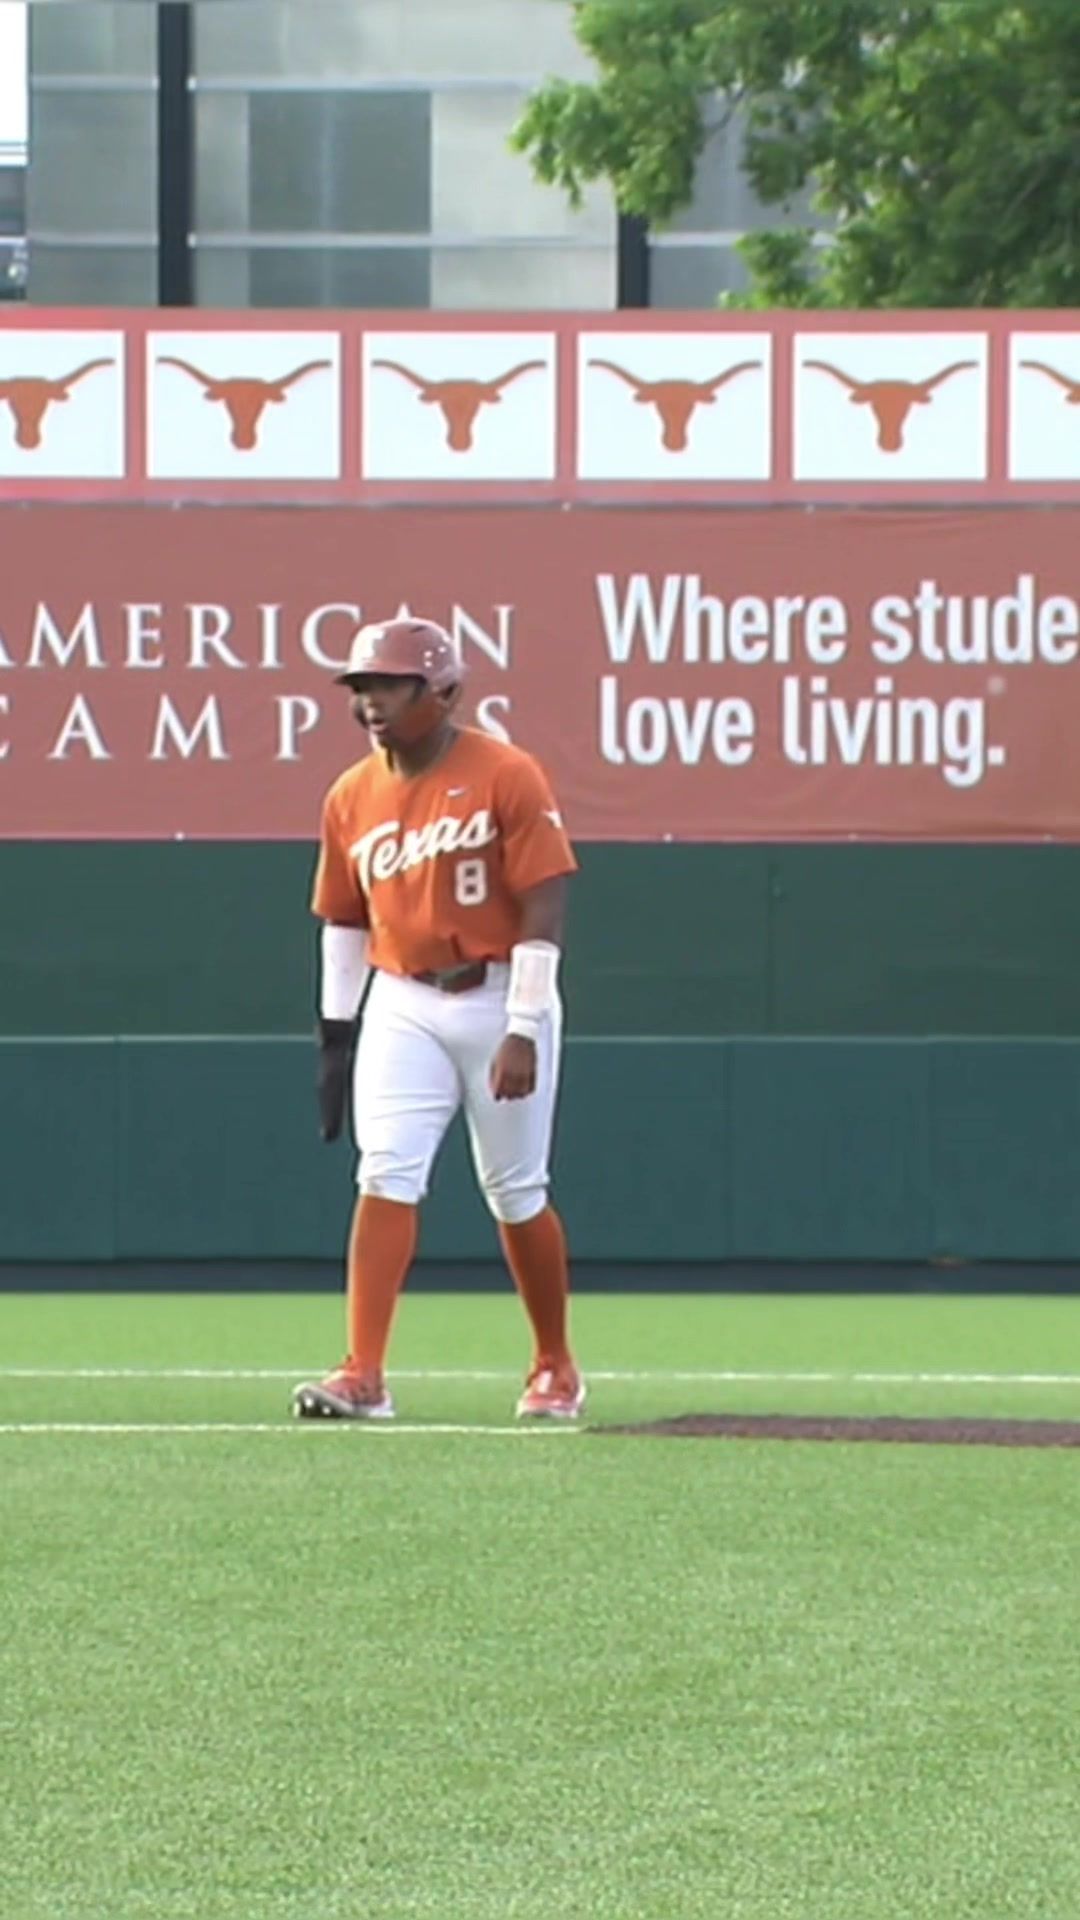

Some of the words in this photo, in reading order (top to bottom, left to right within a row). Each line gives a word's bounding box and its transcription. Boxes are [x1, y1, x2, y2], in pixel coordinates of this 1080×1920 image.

[0, 602, 515, 670] MERICN
[596, 573, 847, 663] Where
[870, 573, 1079, 663] stude
[0, 694, 513, 761] AMPS
[600, 675, 755, 765] love
[783, 675, 1006, 788] living.
[350, 809, 496, 896] Texas
[456, 858, 487, 905] 8
